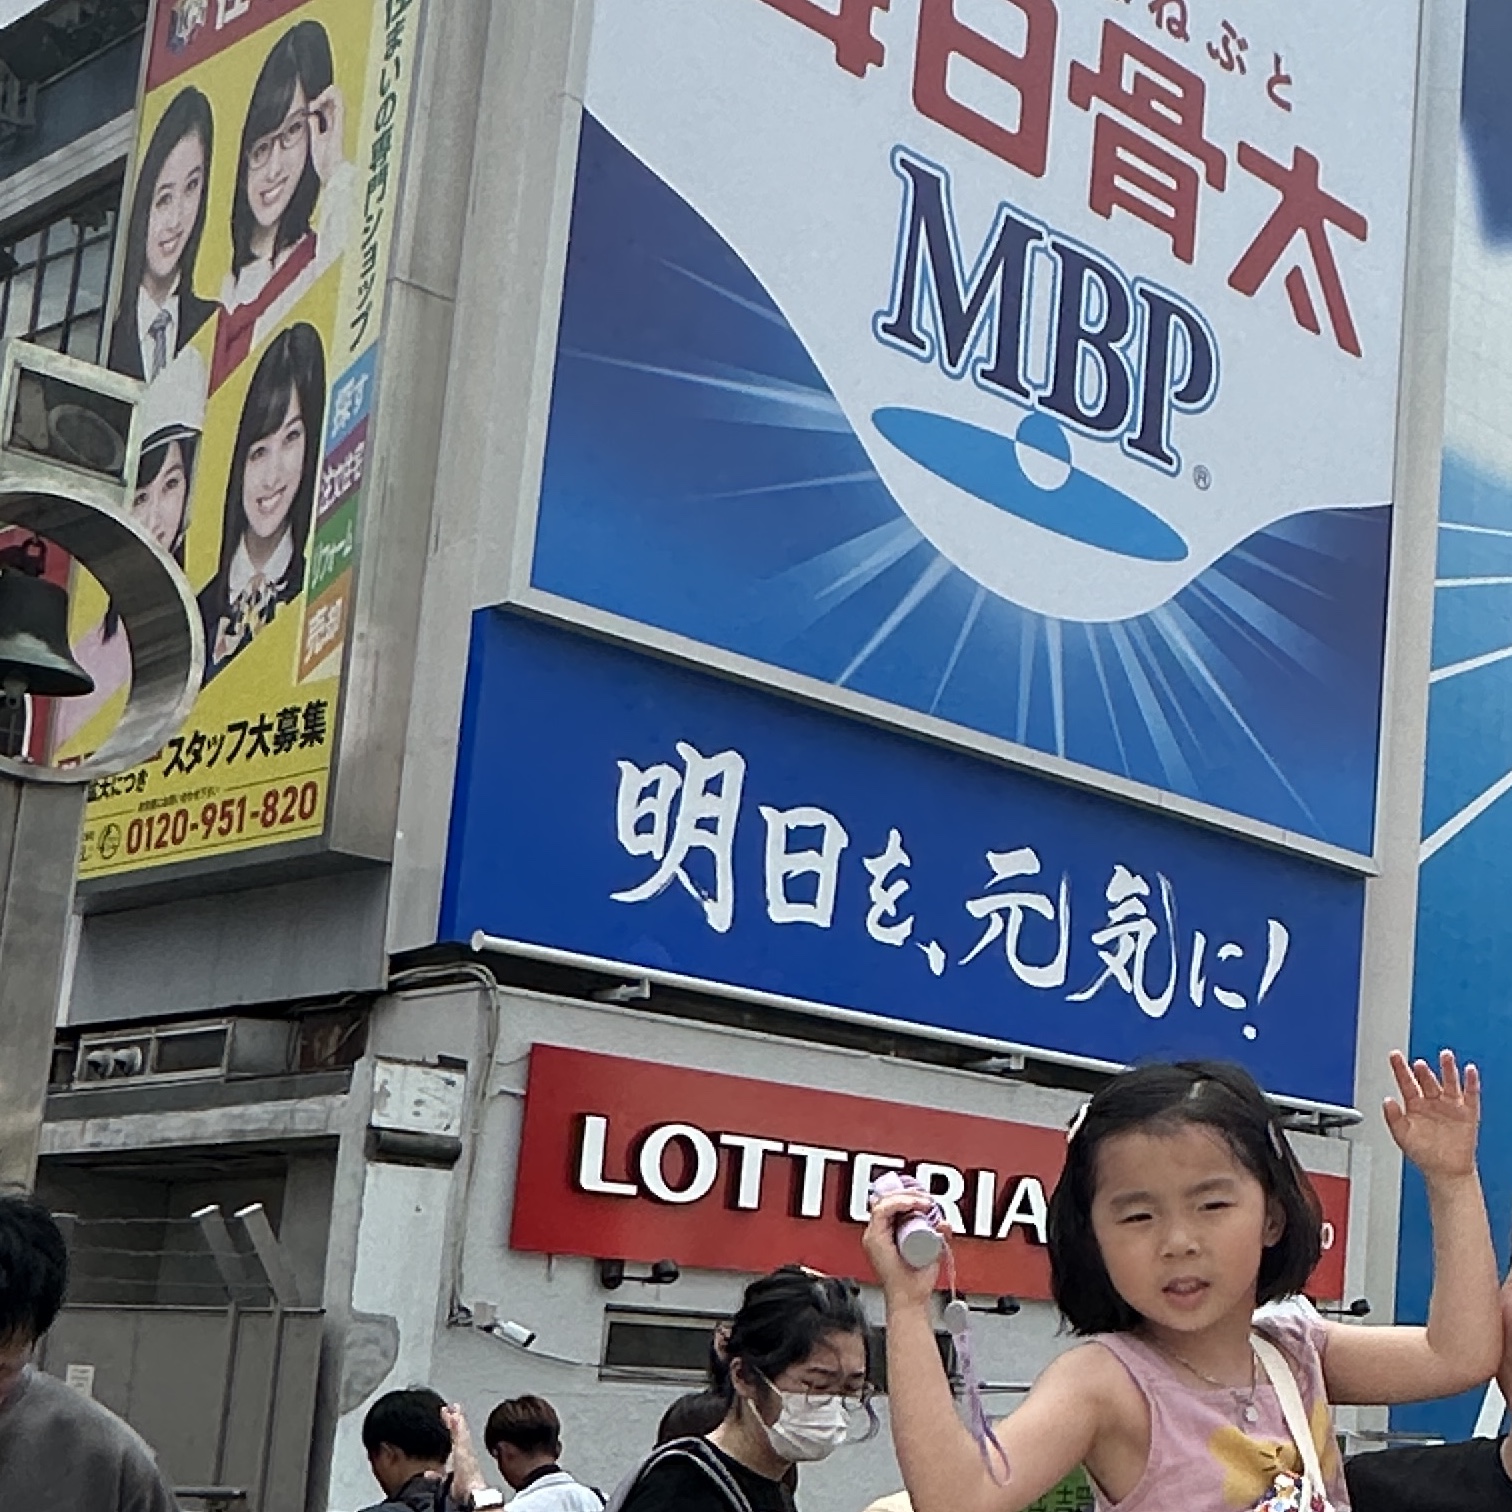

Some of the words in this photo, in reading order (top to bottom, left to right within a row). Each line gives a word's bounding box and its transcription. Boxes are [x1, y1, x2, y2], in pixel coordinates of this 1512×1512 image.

[1117, 0, 1292, 112] ねぶと
[876, 150, 1217, 472] MBP
[163, 699, 328, 778] スタッフ大募集
[126, 780, 319, 855] 0120-951-820
[578, 1115, 1048, 1244] LOTTERIA
